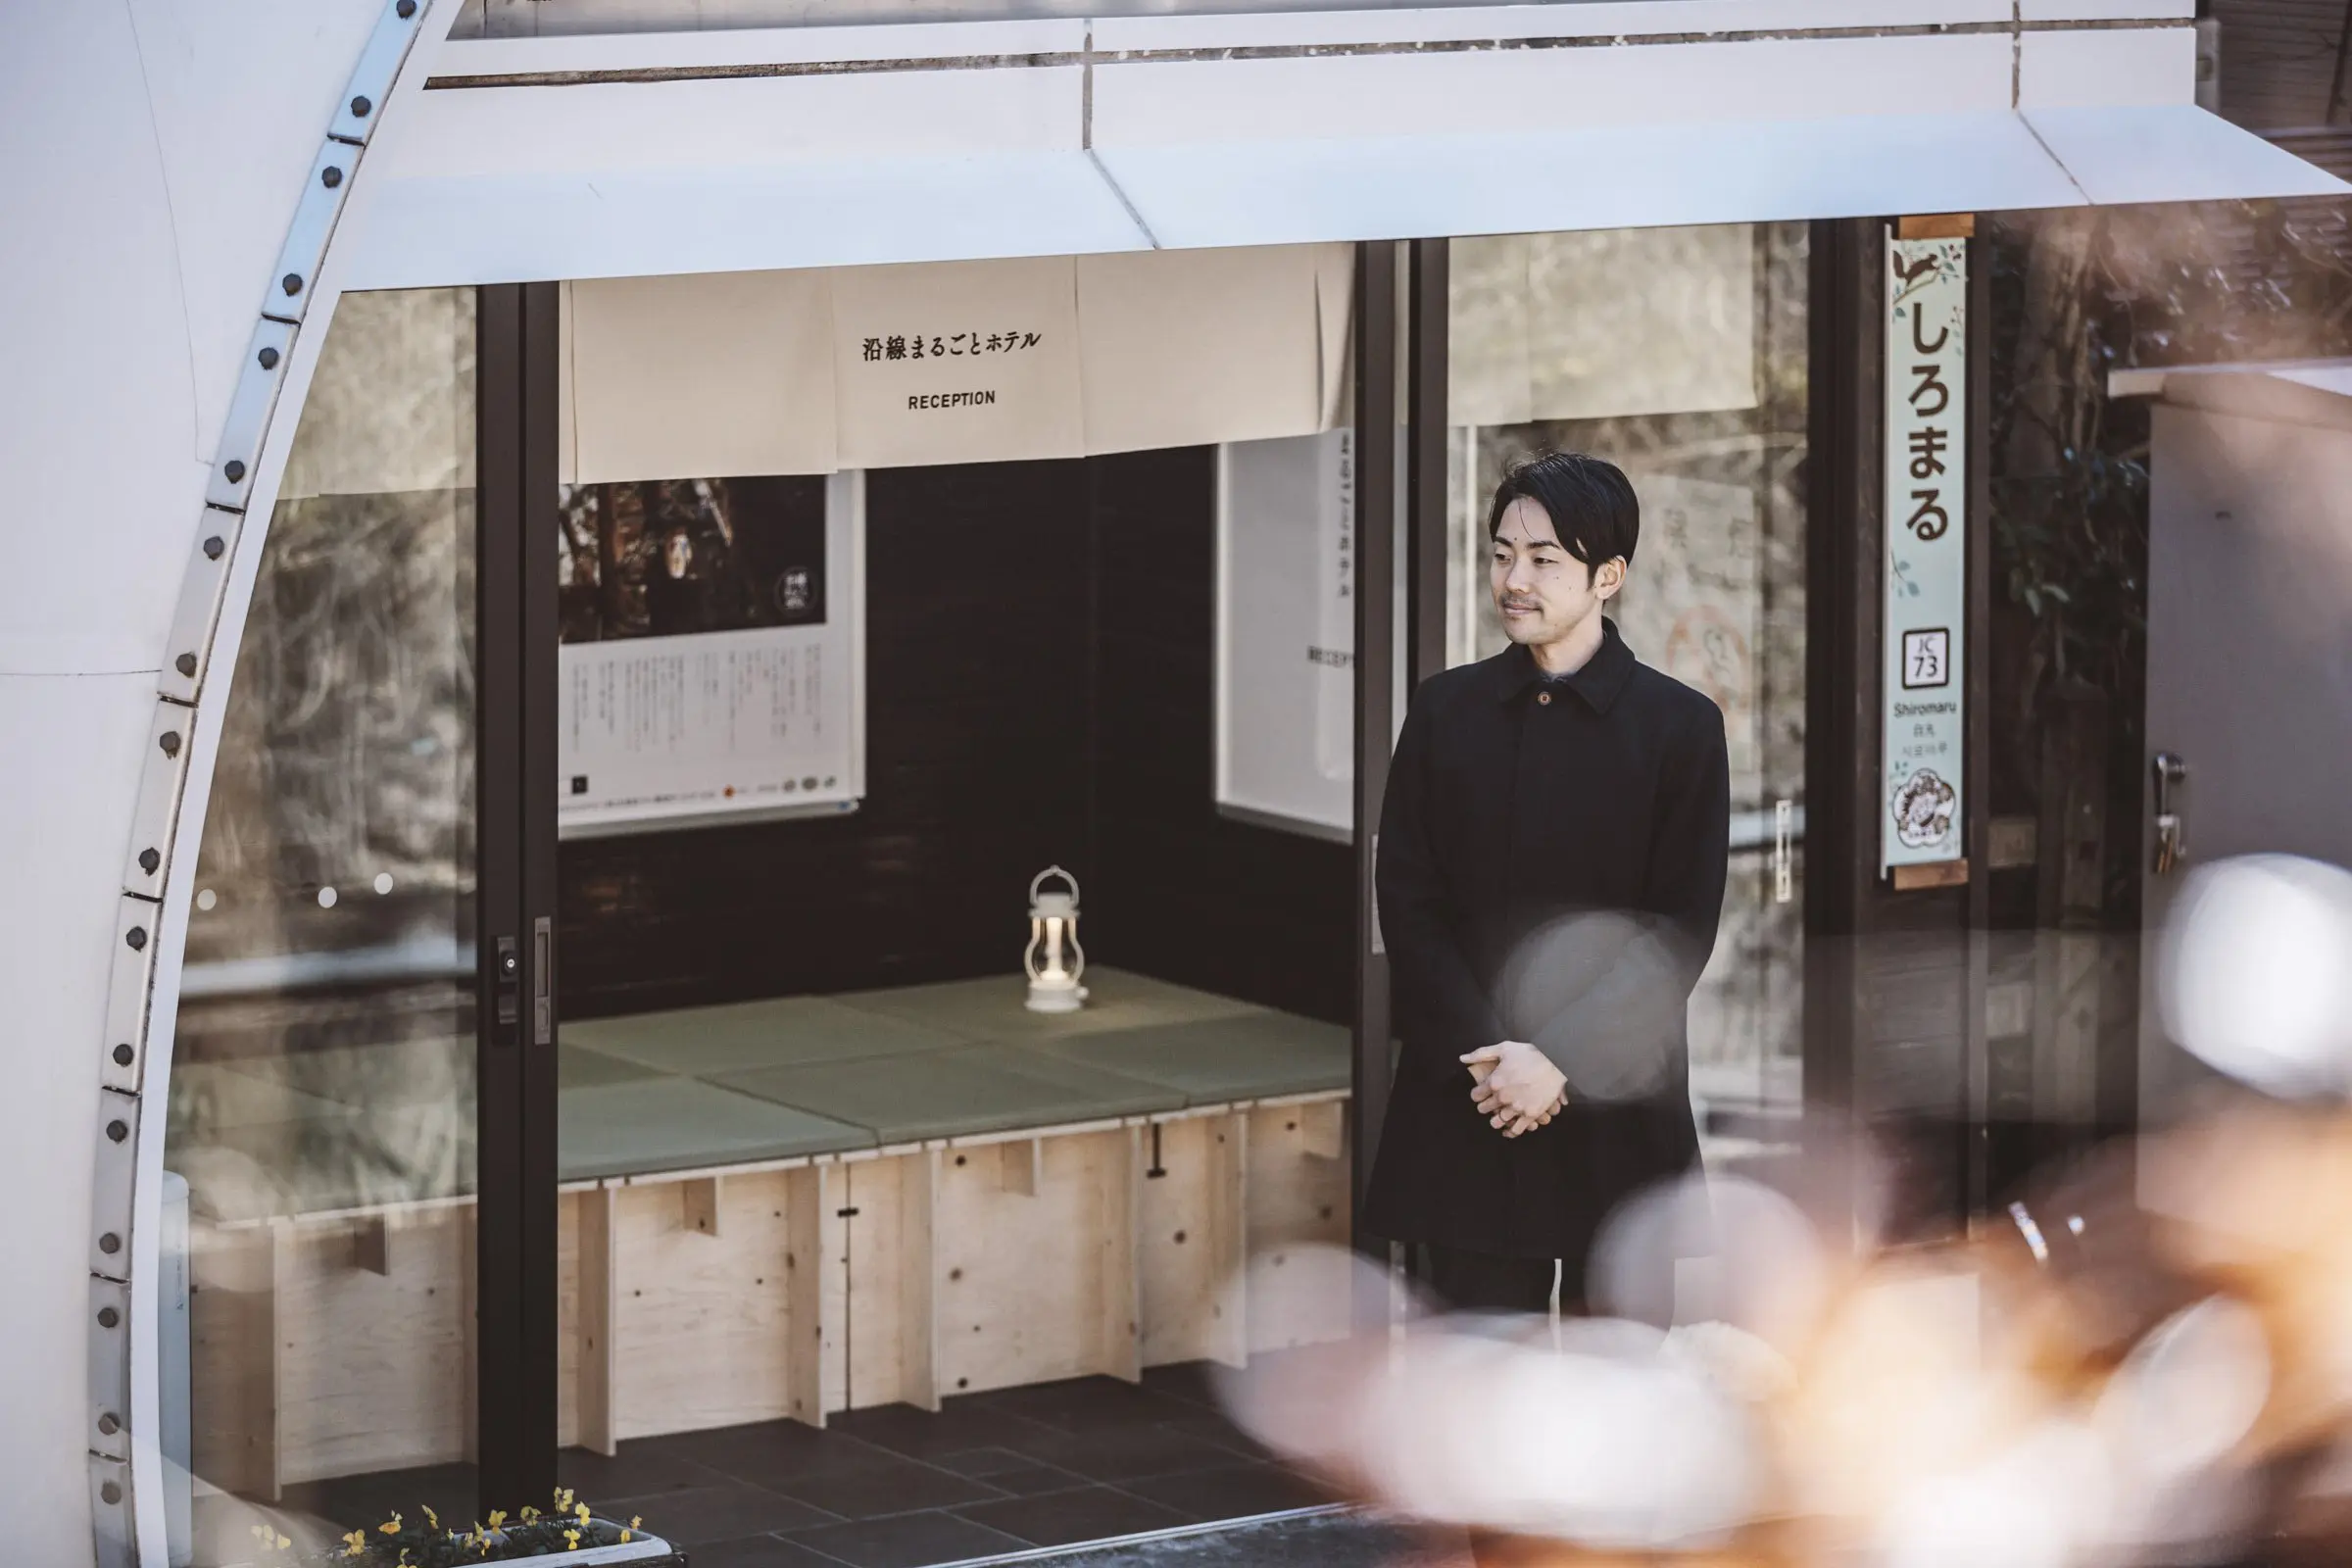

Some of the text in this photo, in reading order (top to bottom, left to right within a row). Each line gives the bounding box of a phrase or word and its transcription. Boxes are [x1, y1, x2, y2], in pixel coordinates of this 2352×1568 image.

[862, 331, 1042, 362] 沿線まるごとホテル
[908, 390, 996, 410] RECEPTION
[1906, 302, 1949, 541] しろまる
[1919, 637, 1936, 653] JC
[1914, 656, 1937, 677] 73
[1894, 703, 1956, 717] Shiromaru
